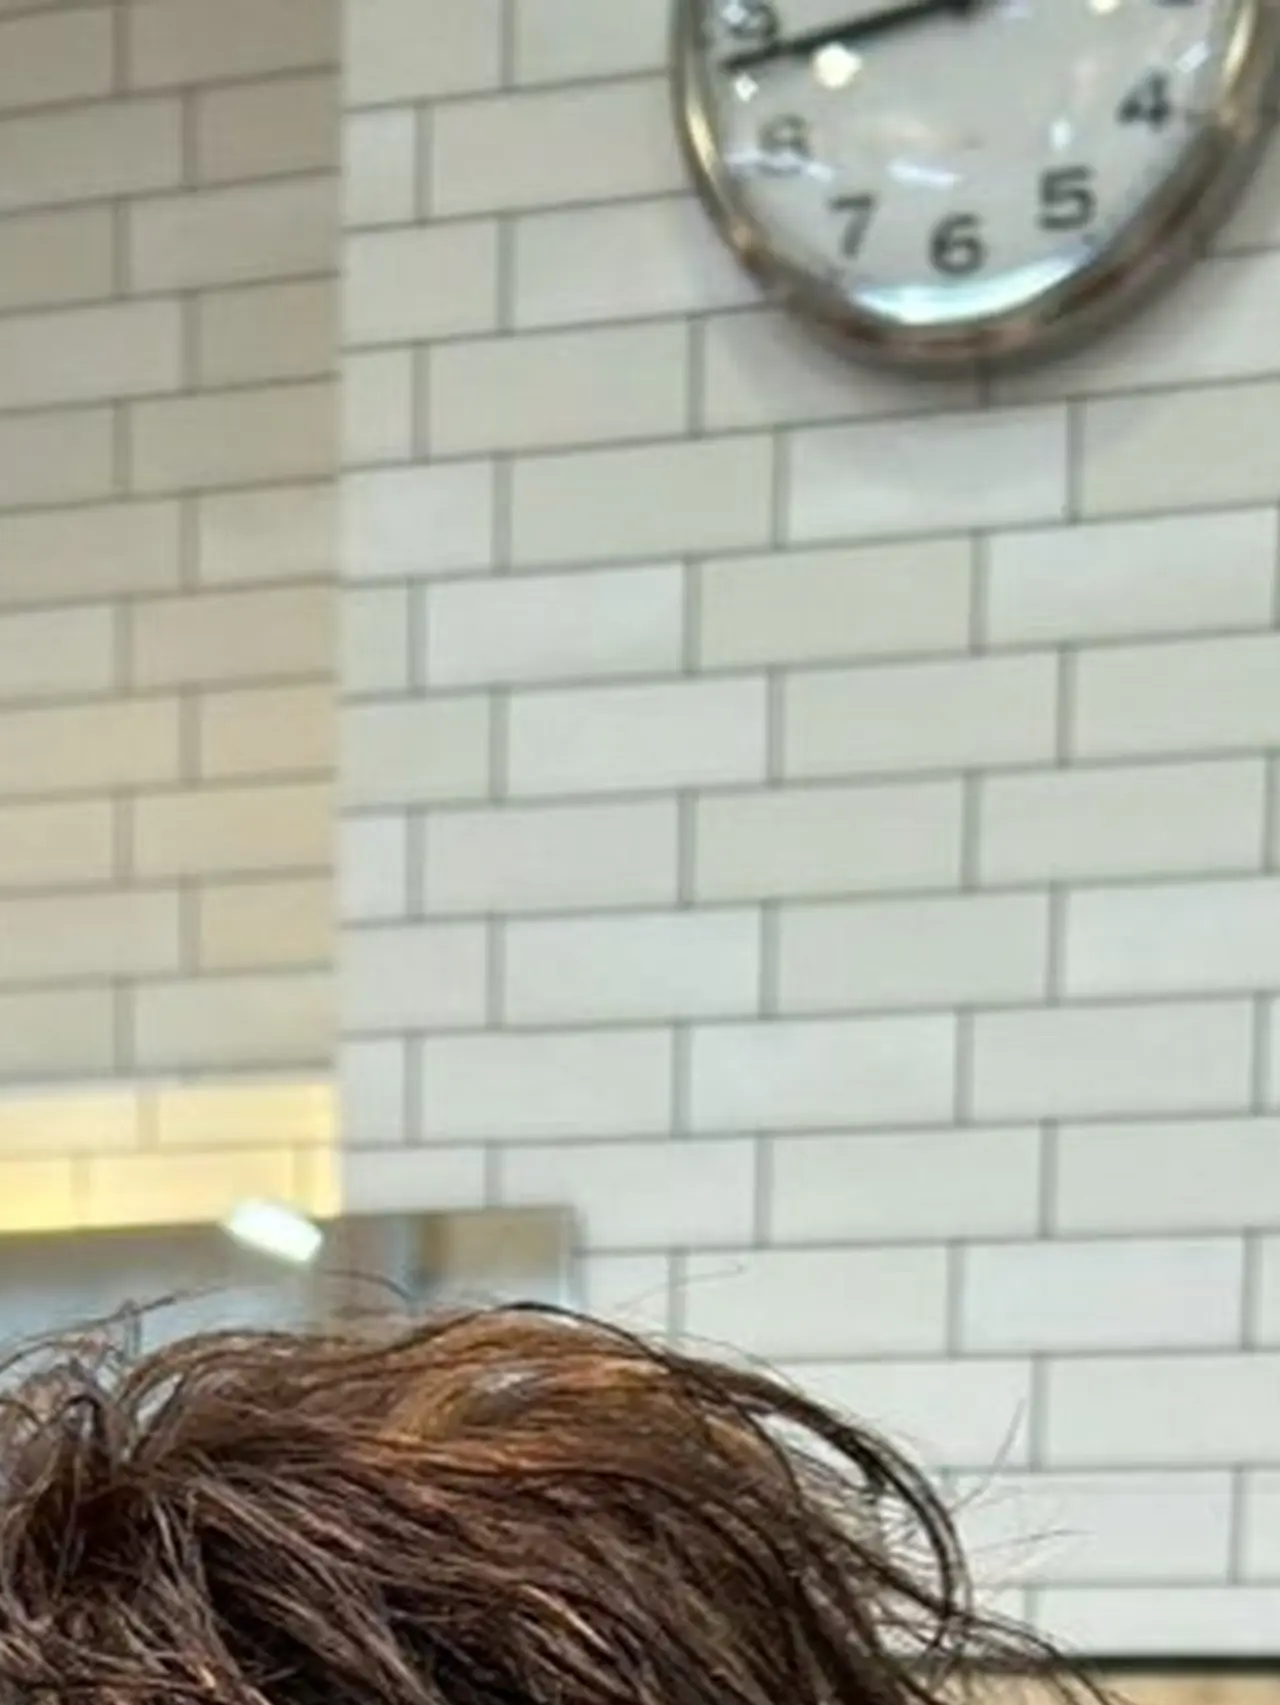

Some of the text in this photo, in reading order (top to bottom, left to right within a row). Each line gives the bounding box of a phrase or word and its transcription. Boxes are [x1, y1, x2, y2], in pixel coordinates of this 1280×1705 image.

[1118, 70, 1169, 131] 4
[828, 195, 875, 257] 7
[1039, 166, 1095, 230] 5
[929, 214, 987, 275] 6
